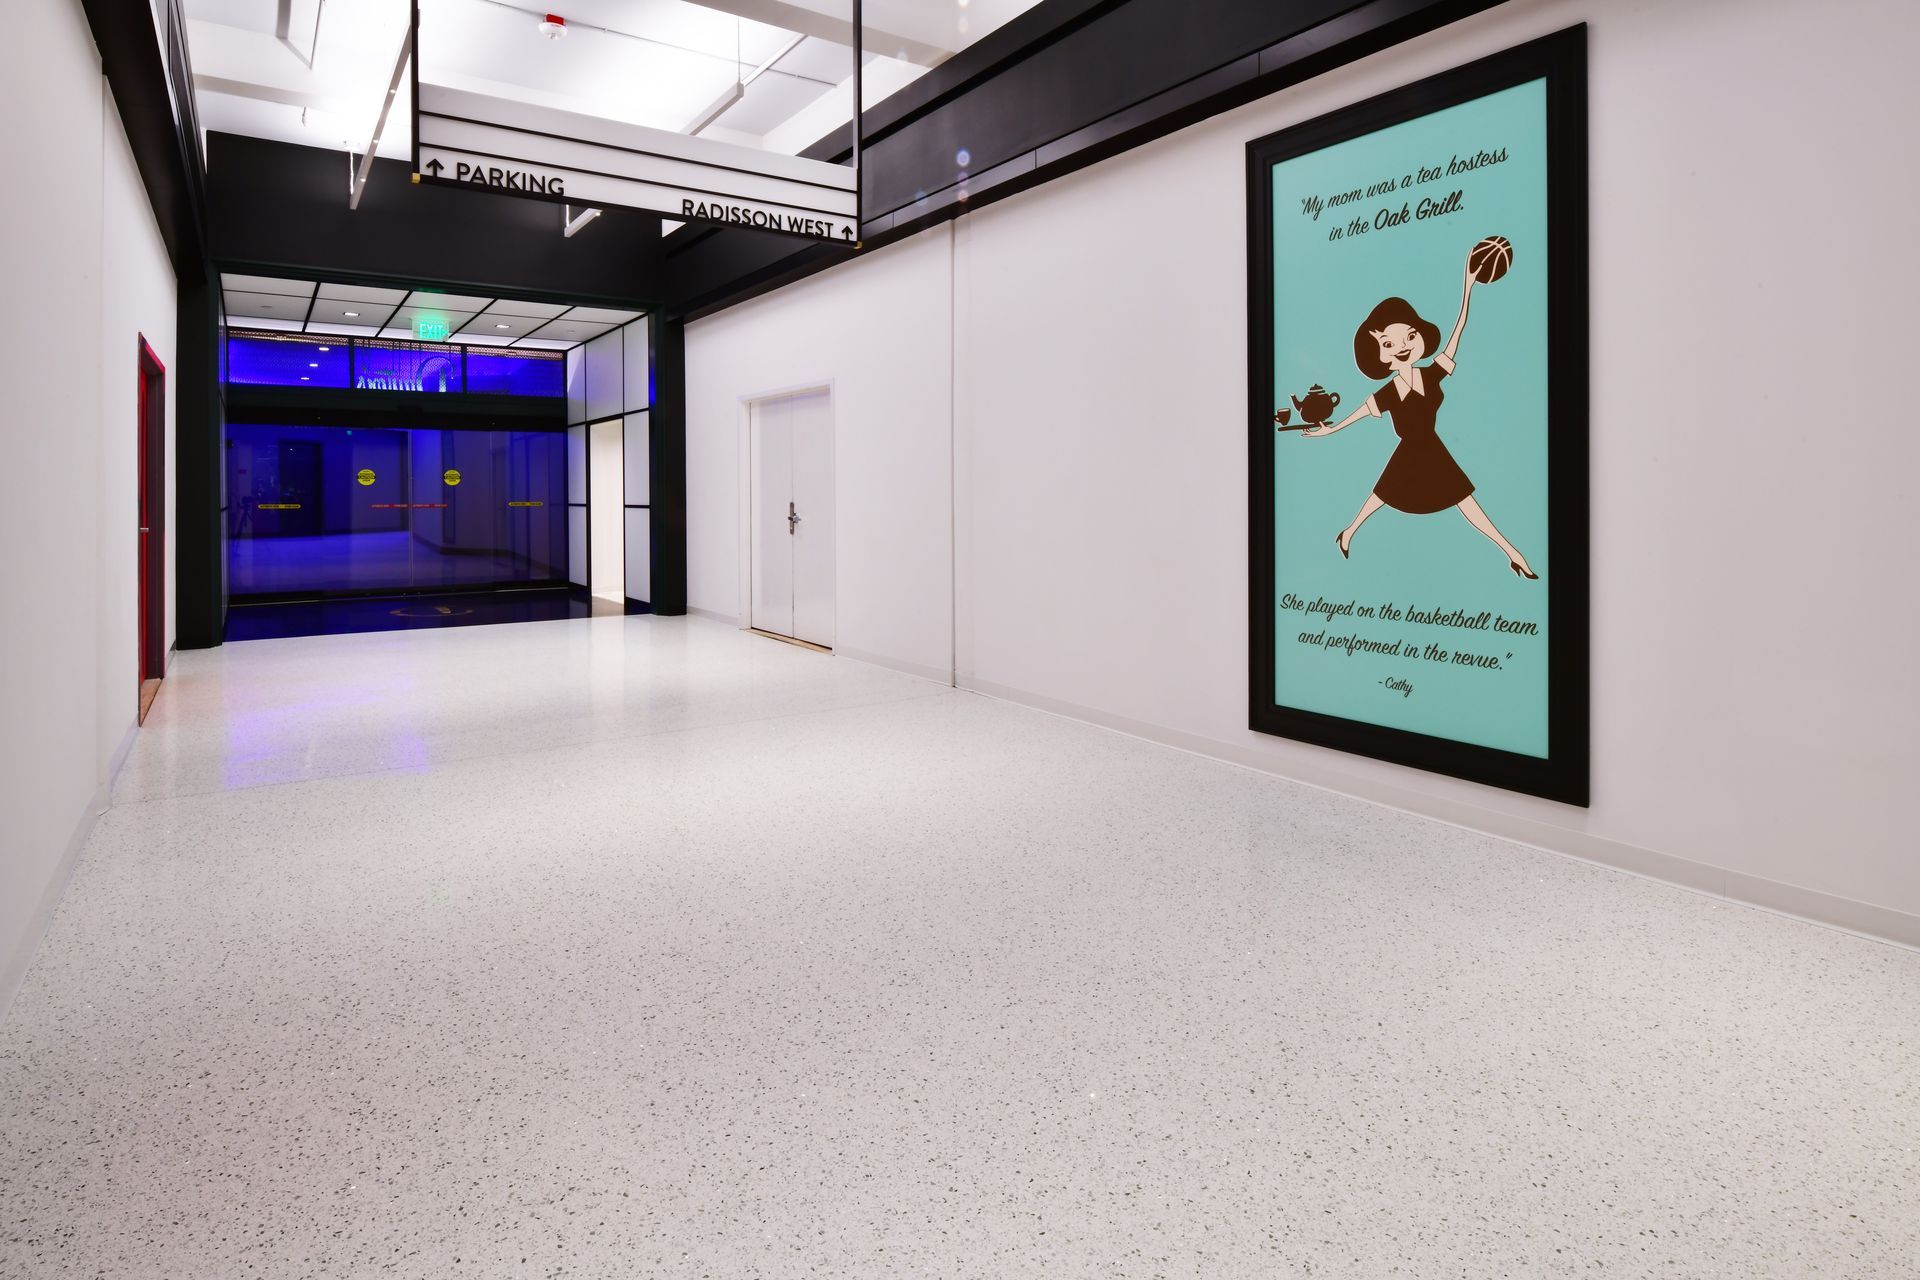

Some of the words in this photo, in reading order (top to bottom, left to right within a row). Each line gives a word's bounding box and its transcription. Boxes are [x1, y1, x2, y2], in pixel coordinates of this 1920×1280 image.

[456, 162, 564, 196] PARKING
[1328, 188, 1362, 208] mom
[1367, 178, 1397, 198] was
[1401, 174, 1412, 188] a
[1416, 166, 1442, 184] tea
[1446, 147, 1508, 177] hostess
[682, 199, 782, 230] RADISSON
[787, 217, 834, 239] WEST
[1329, 223, 1343, 242] in
[1347, 216, 1369, 237] the
[1374, 203, 1410, 230] Oak
[1416, 190, 1463, 220] Grill.
[419, 323, 444, 339] EXIT
[1280, 594, 1304, 610] She
[1306, 596, 1354, 622] played
[1357, 606, 1374, 618] on
[1379, 603, 1402, 620] the
[1405, 605, 1491, 630] basketball
[1494, 614, 1539, 636] team
[1298, 630, 1324, 645] and
[1325, 634, 1402, 656] performed
[1404, 644, 1419, 658] in
[1424, 644, 1448, 662] the
[1385, 677, 1413, 698] Cathy
